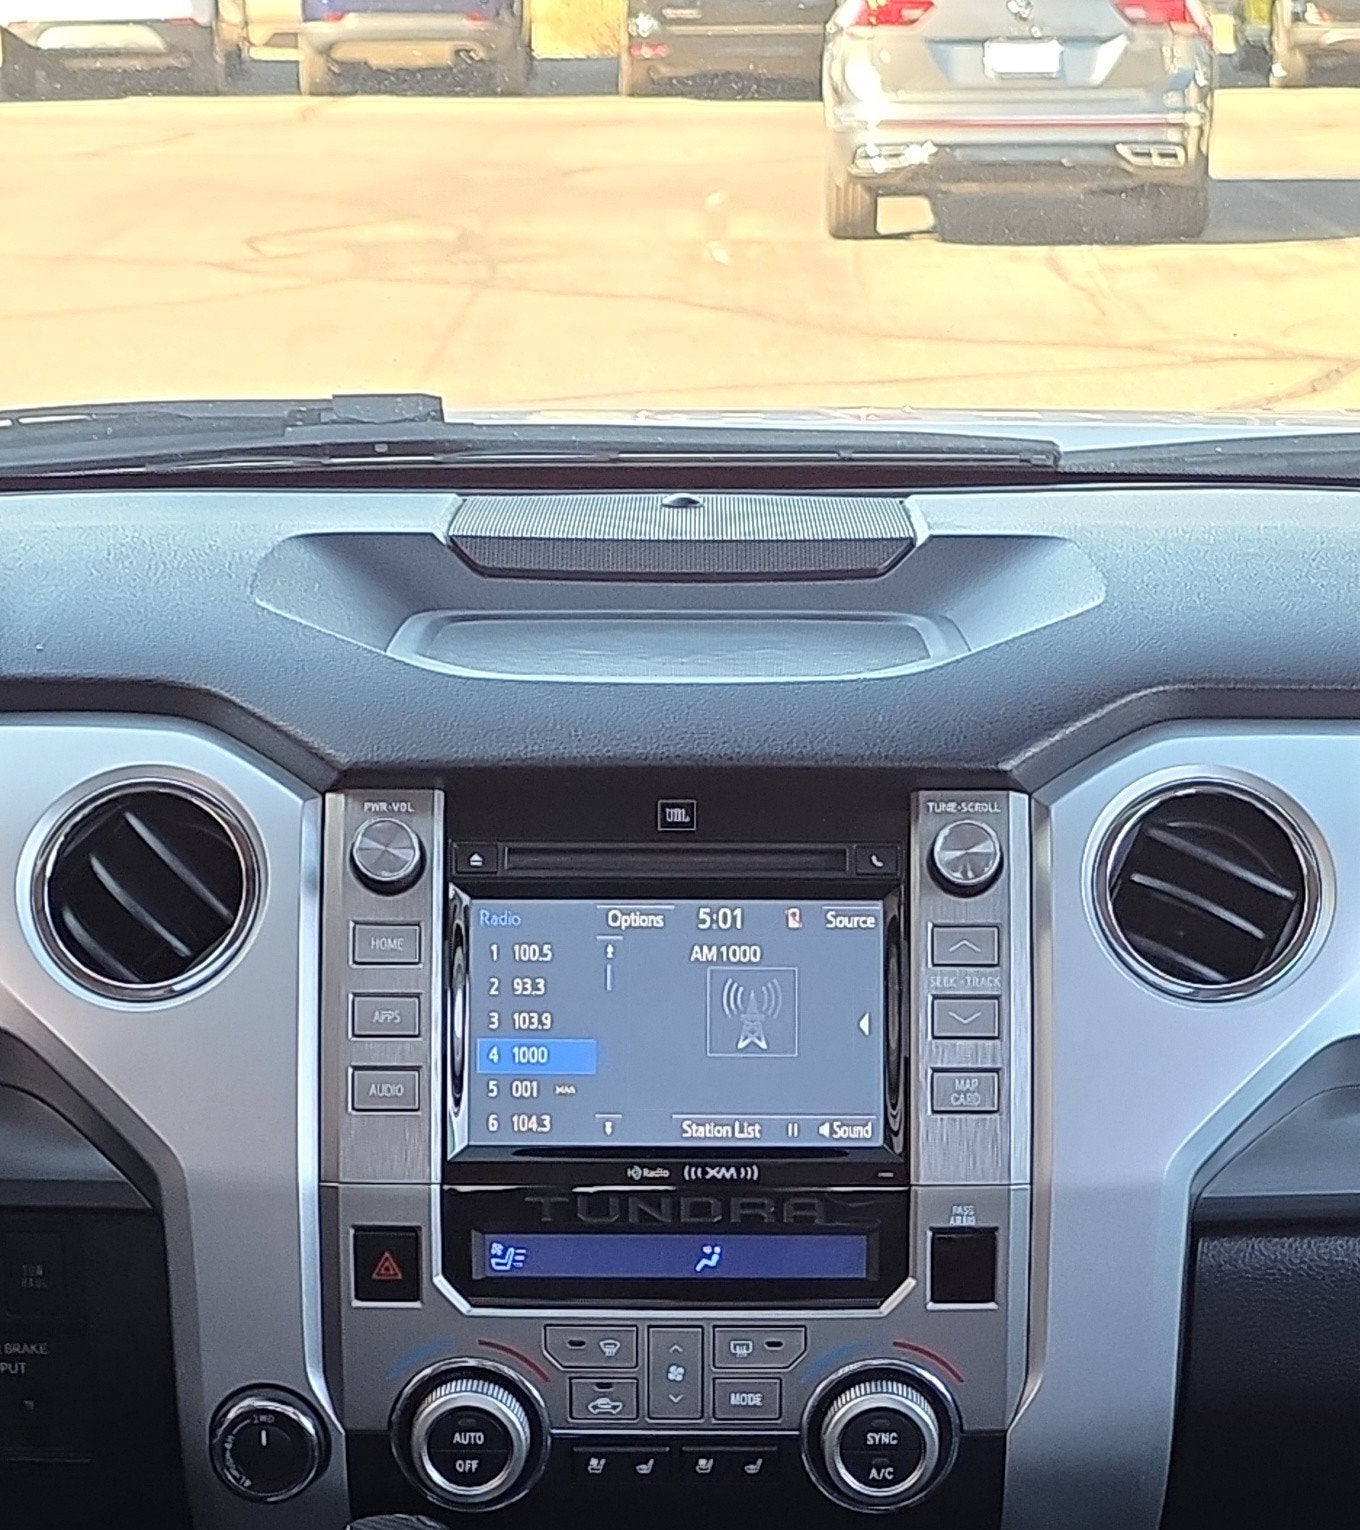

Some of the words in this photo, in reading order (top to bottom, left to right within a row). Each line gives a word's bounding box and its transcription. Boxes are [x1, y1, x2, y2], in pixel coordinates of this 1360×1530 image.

[479, 910, 521, 926] Radio
[607, 910, 664, 930] Options
[698, 908, 743, 929] 5:01
[826, 911, 876, 928] Source
[371, 938, 404, 950] HOME
[490, 944, 498, 961] 1
[513, 944, 553, 961] 100.5
[690, 946, 717, 962] AM
[720, 946, 761, 962] 1000
[489, 978, 499, 995] 2
[513, 978, 546, 995] 93.3
[373, 1012, 401, 1023] APPS
[489, 1012, 499, 1029] 3
[513, 1012, 552, 1029] 103.9
[488, 1047, 499, 1063] 4
[512, 1047, 549, 1063] 1000
[369, 1085, 404, 1096] AUDIO
[488, 1081, 498, 1098] 5
[511, 1081, 539, 1098] 001
[955, 1079, 979, 1090] MAP
[950, 1094, 981, 1106] CARD
[488, 1114, 499, 1132] 6
[512, 1114, 552, 1132] 104.3
[682, 1120, 732, 1138] Station
[734, 1120, 762, 1138] List
[832, 1121, 872, 1138] Sound
[525, 1197, 827, 1223] TUNDRA
[4, 1343, 48, 1355] BRAKE
[730, 1393, 763, 1406] MODE
[453, 1432, 484, 1445] AUTO
[866, 1433, 898, 1445] SYNC
[455, 1459, 479, 1472] OFF
[869, 1468, 894, 1480] A/C
